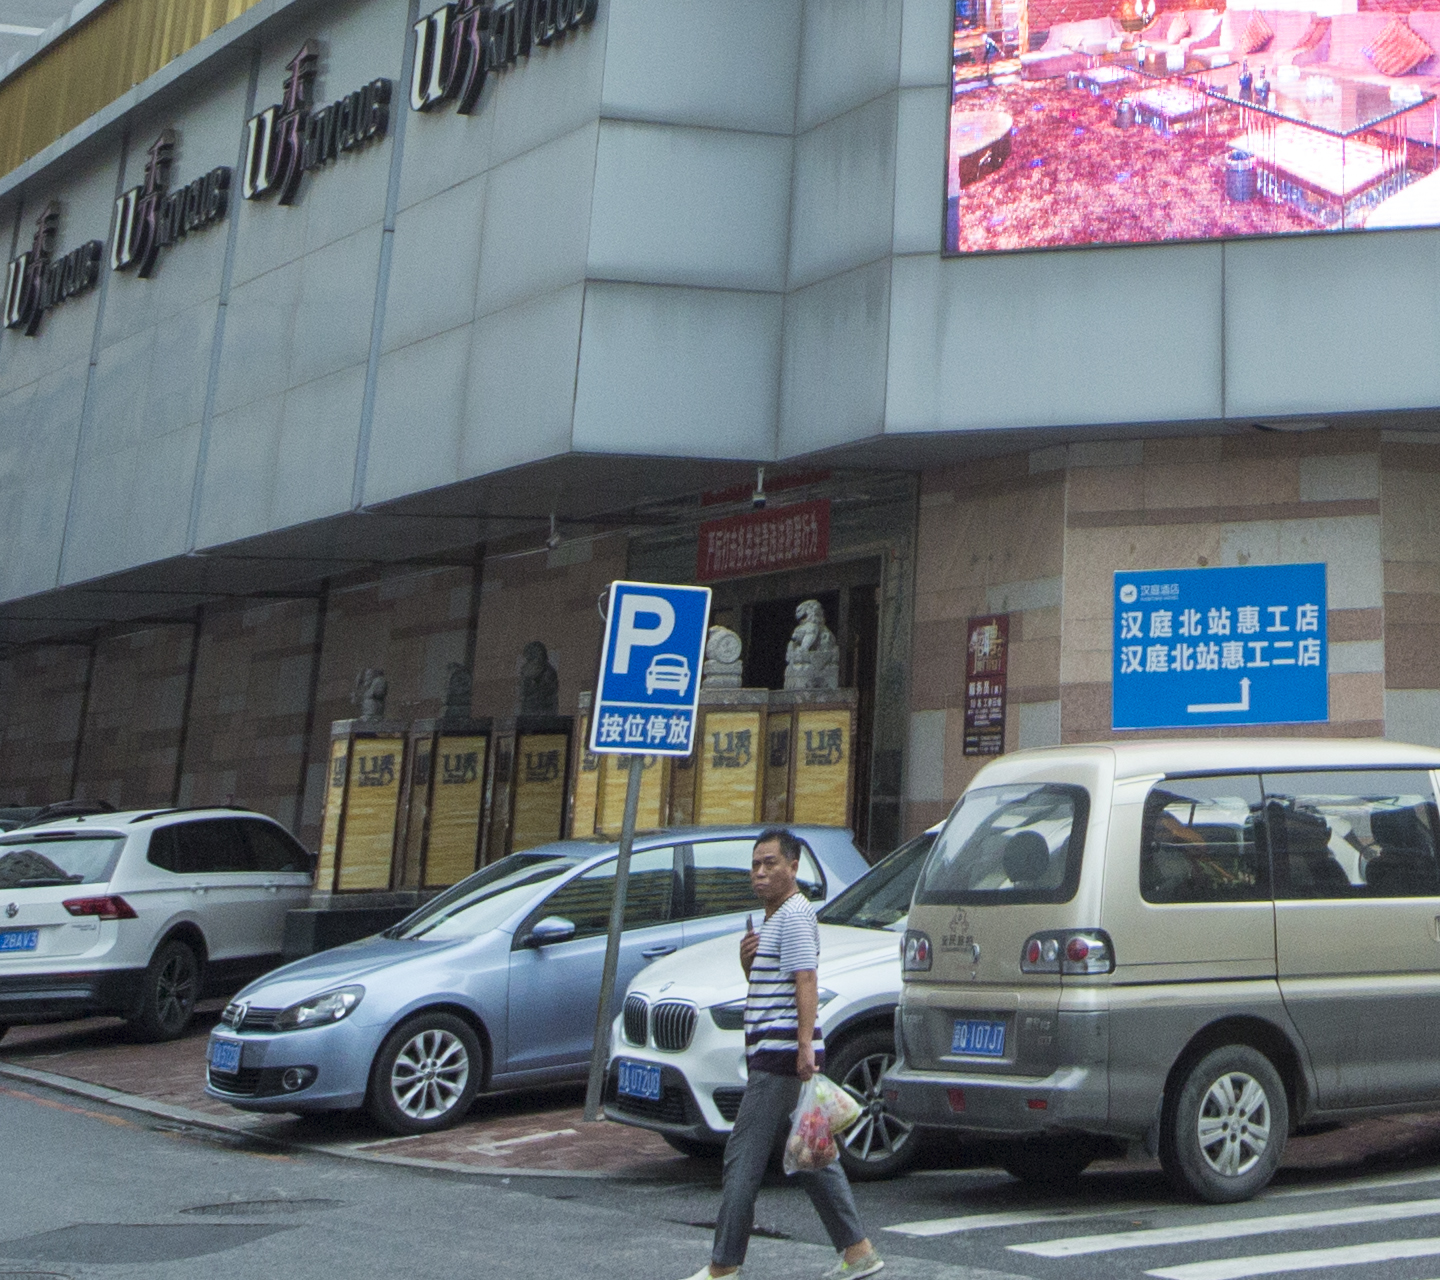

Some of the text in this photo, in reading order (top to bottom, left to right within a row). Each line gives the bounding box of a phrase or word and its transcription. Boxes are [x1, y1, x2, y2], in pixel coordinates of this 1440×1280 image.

[612, 593, 676, 675] P
[1121, 603, 1320, 640] 汉庭北站惠工店
[1120, 638, 1322, 674] 汉庭北站惠工二店
[599, 712, 690, 745] 按位停放
